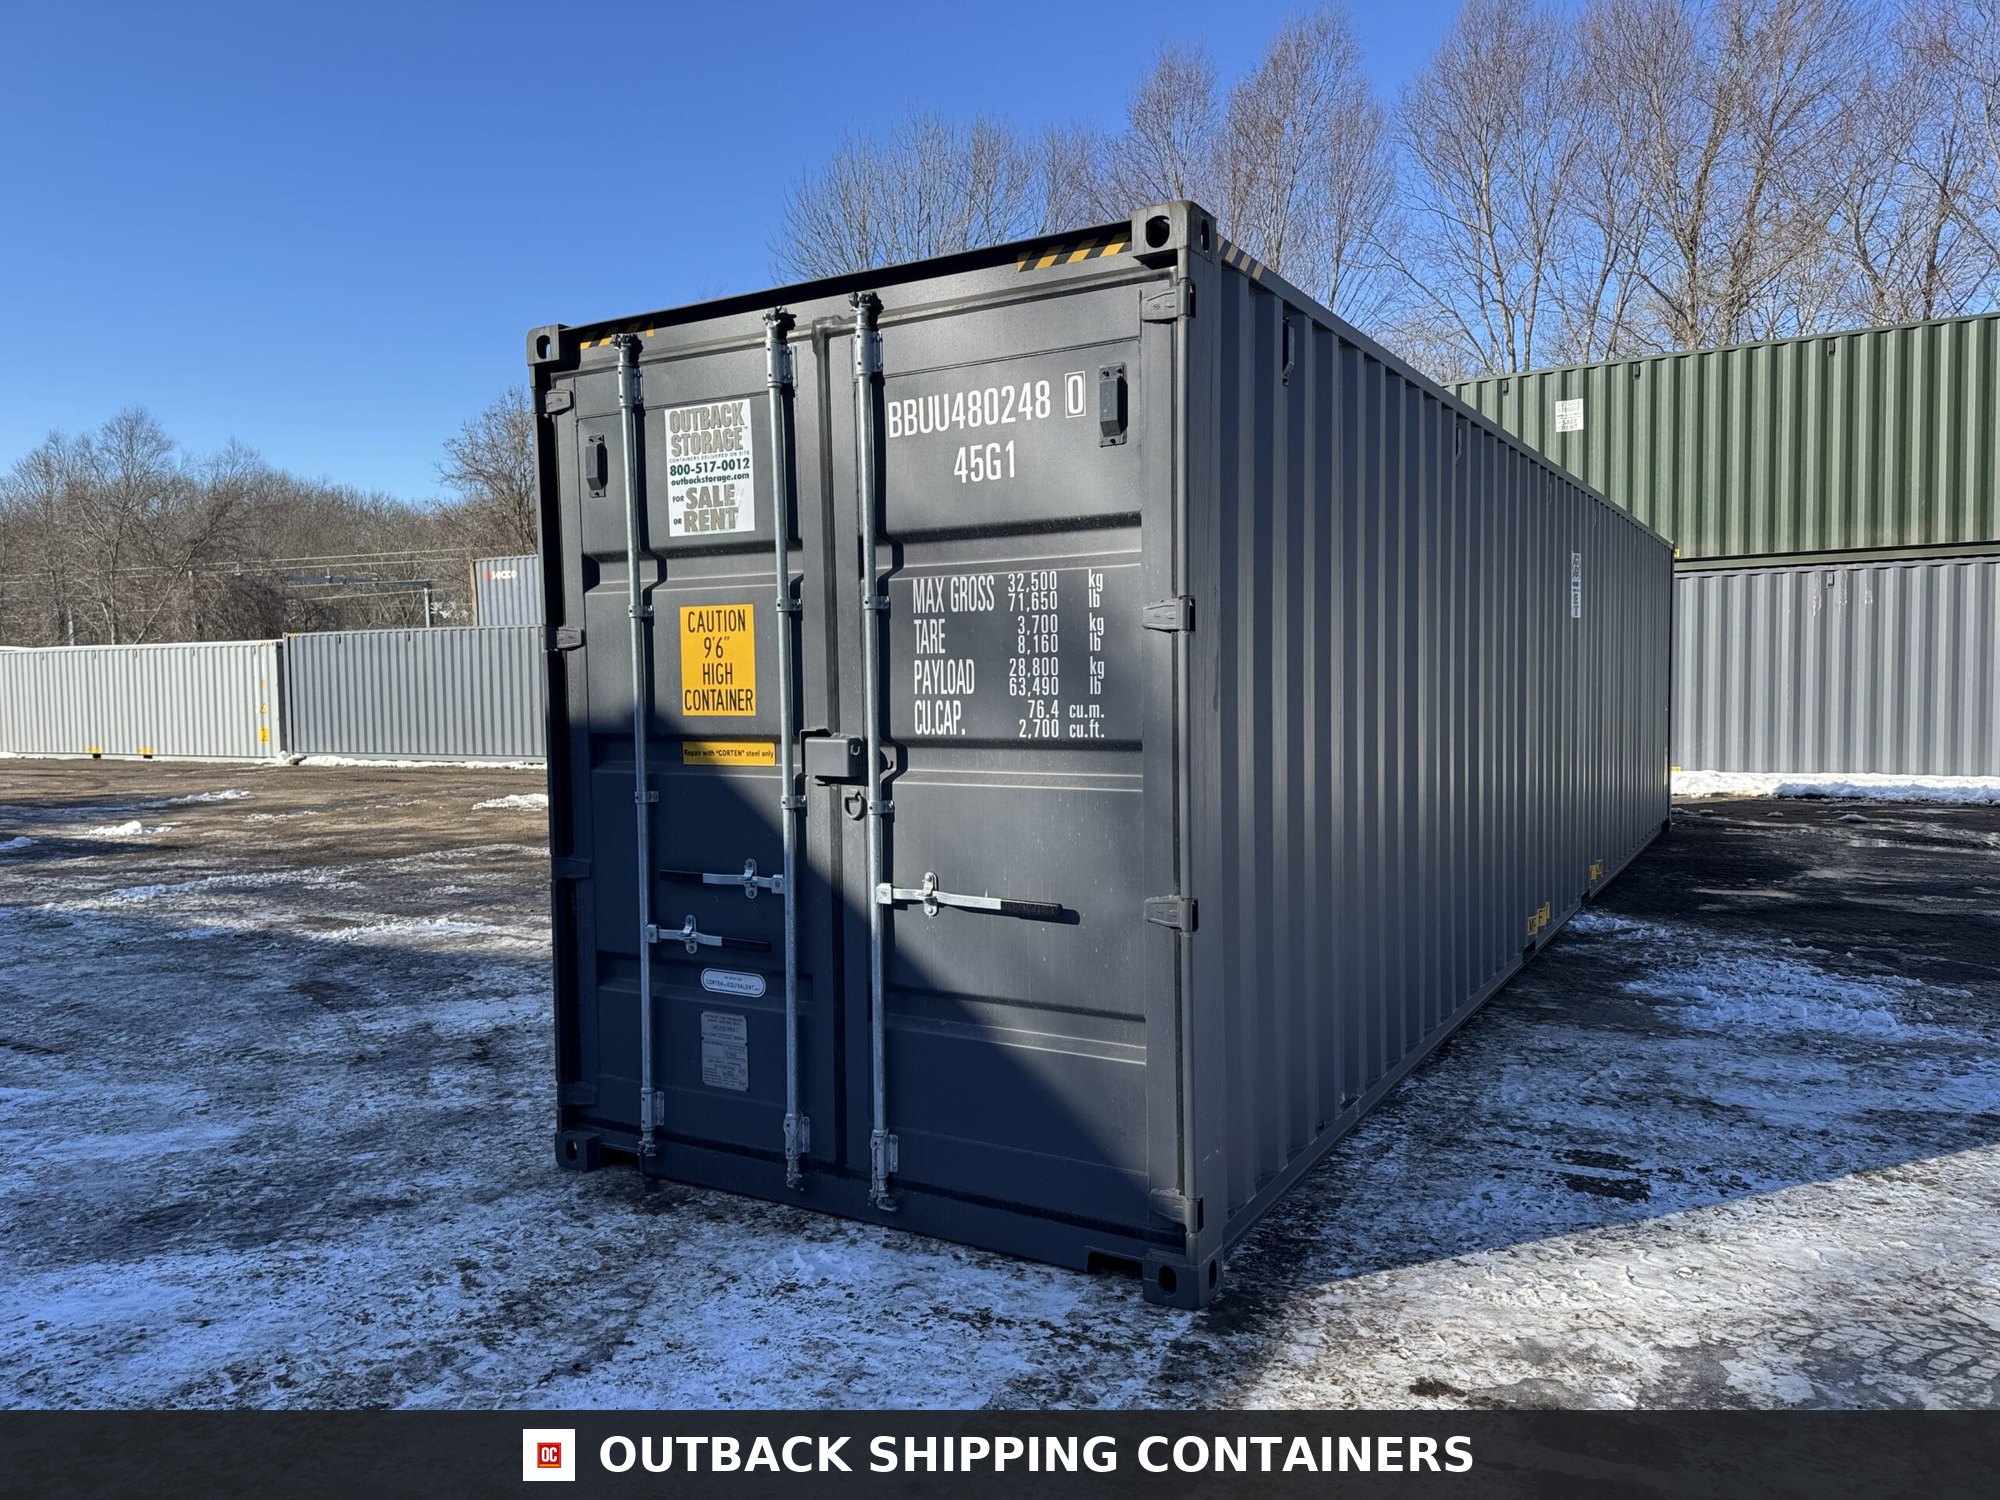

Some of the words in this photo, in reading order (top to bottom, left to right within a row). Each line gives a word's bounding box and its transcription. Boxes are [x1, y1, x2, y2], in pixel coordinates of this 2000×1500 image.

[669, 402, 745, 433] OUTBACK
[888, 380, 1050, 438] BBUU480248
[1067, 375, 1083, 414] 0
[671, 427, 743, 457] STORAGE
[669, 455, 700, 463] CONTAINERS
[670, 458, 750, 476] 800-517-0012
[954, 440, 1015, 483] 45G1
[671, 473, 749, 486] outbackstorage.com
[686, 484, 735, 509] SALE
[684, 507, 738, 532] RENT
[913, 577, 945, 613] MAX
[950, 575, 995, 612] GROSS
[1008, 571, 1057, 593] 32,500
[1088, 568, 1103, 592] kg
[1008, 591, 1058, 612] 71,650
[1089, 589, 1100, 608] lb
[688, 609, 746, 633] CAUTION
[914, 618, 946, 654] TARE
[1018, 614, 1058, 636] 3,700
[1089, 613, 1104, 635] kg
[1018, 634, 1058, 655] 8,160
[1090, 633, 1101, 652] lb
[702, 662, 733, 685] HIGH
[914, 659, 975, 695] PAYLOAD
[1009, 657, 1058, 678] 28,800
[1090, 656, 1105, 679] kg
[1009, 676, 1059, 697] 63,490
[1090, 676, 1101, 695] lb
[684, 689, 753, 711] CONTAINER
[914, 700, 966, 735] CU.CAP.
[1028, 700, 1059, 718] 76.4
[1069, 703, 1105, 718] cu.m.
[1019, 719, 1059, 739] 2,700
[1069, 720, 1105, 738] cu.ft.
[684, 749, 701, 757] Repair
[702, 749, 714, 757] with
[761, 750, 774, 759] only
